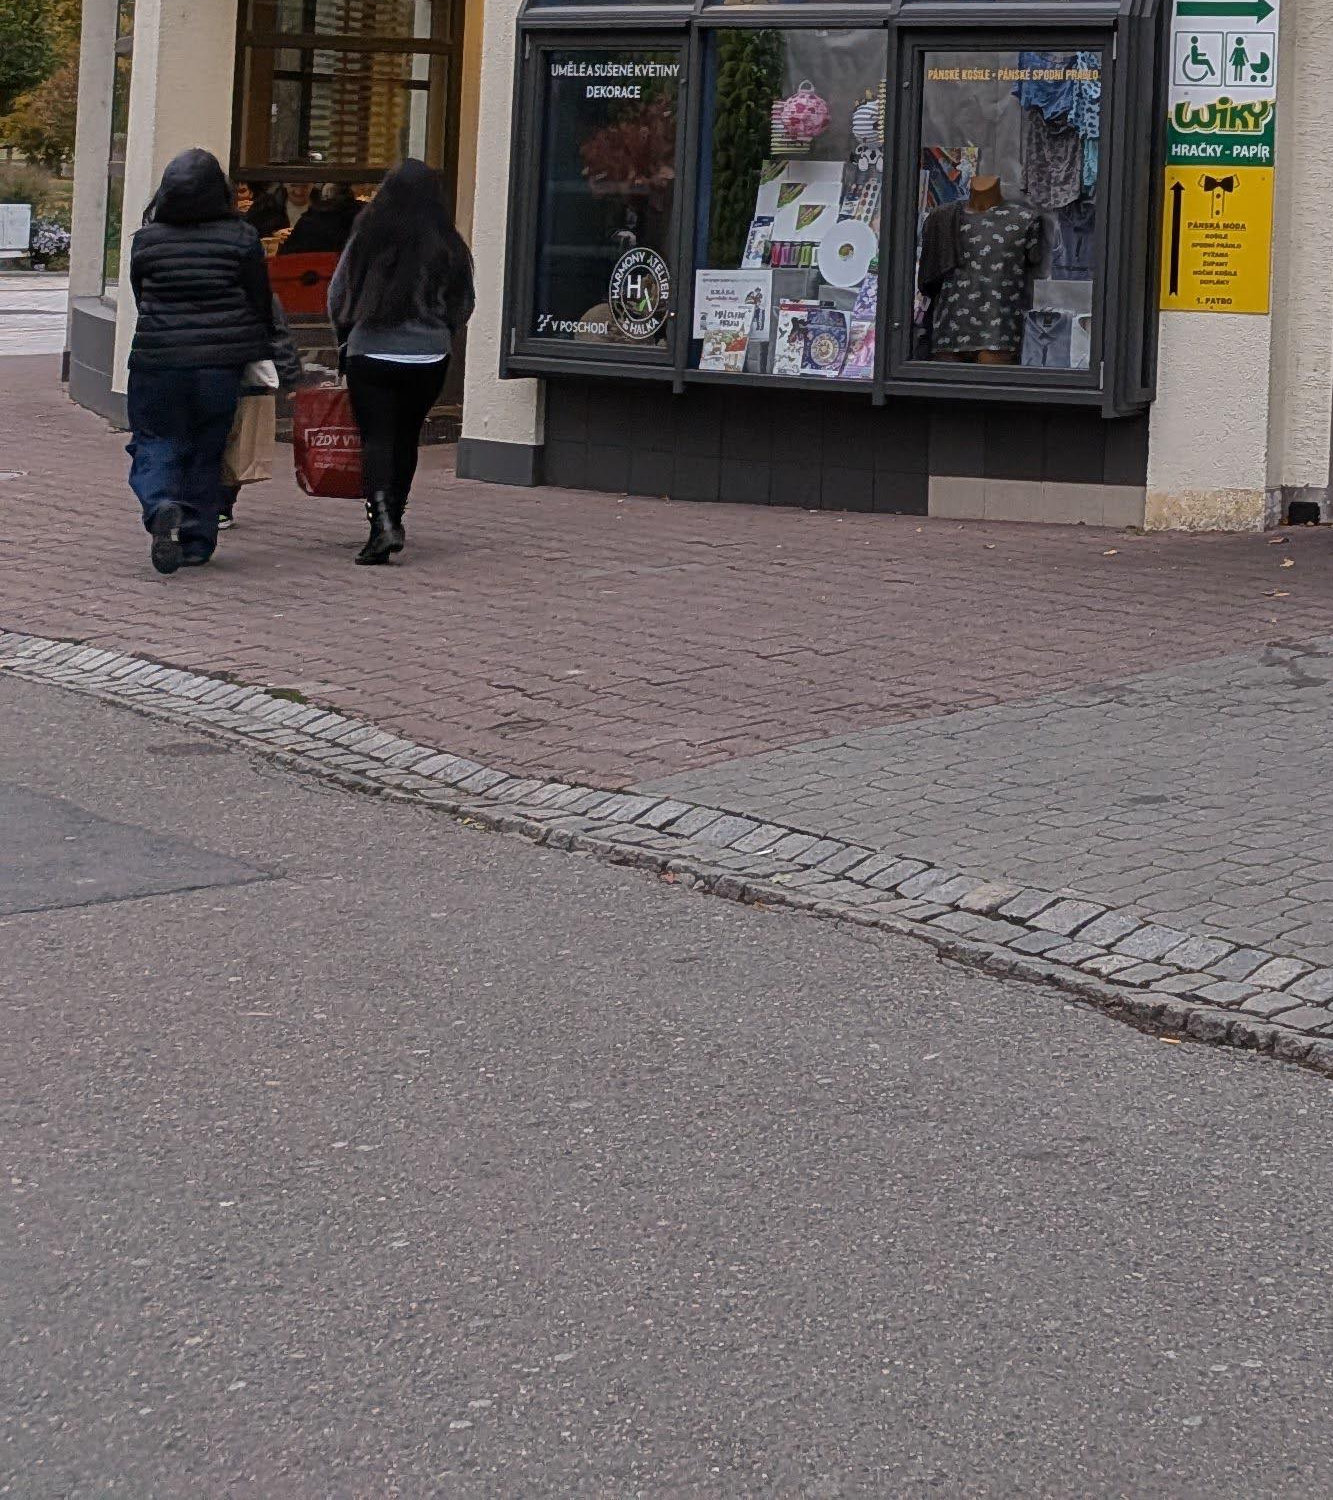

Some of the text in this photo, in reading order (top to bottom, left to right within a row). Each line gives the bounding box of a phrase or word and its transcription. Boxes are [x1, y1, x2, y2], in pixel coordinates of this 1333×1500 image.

[551, 61, 586, 77] UMĚLÉ
[594, 61, 634, 77] SUŠENÉ
[635, 61, 680, 77] KVĚTINY
[927, 66, 960, 81] PÁNSKÉ
[961, 66, 990, 81] KOŠILE
[997, 67, 1031, 81] PÁNSKÉ
[1032, 67, 1064, 81] SPODNÍ
[586, 85, 641, 99] DEKORACE
[1171, 142, 1223, 158] HRAČKY
[1232, 143, 1270, 158] PAPÍR
[1187, 221, 1220, 230] PÁNSKÁ
[611, 251, 669, 300] HARMONY ATELIER
[1205, 297, 1233, 305] PATRO
[551, 320, 609, 335] V POSCHODÍ
[629, 318, 660, 335] HALKA
